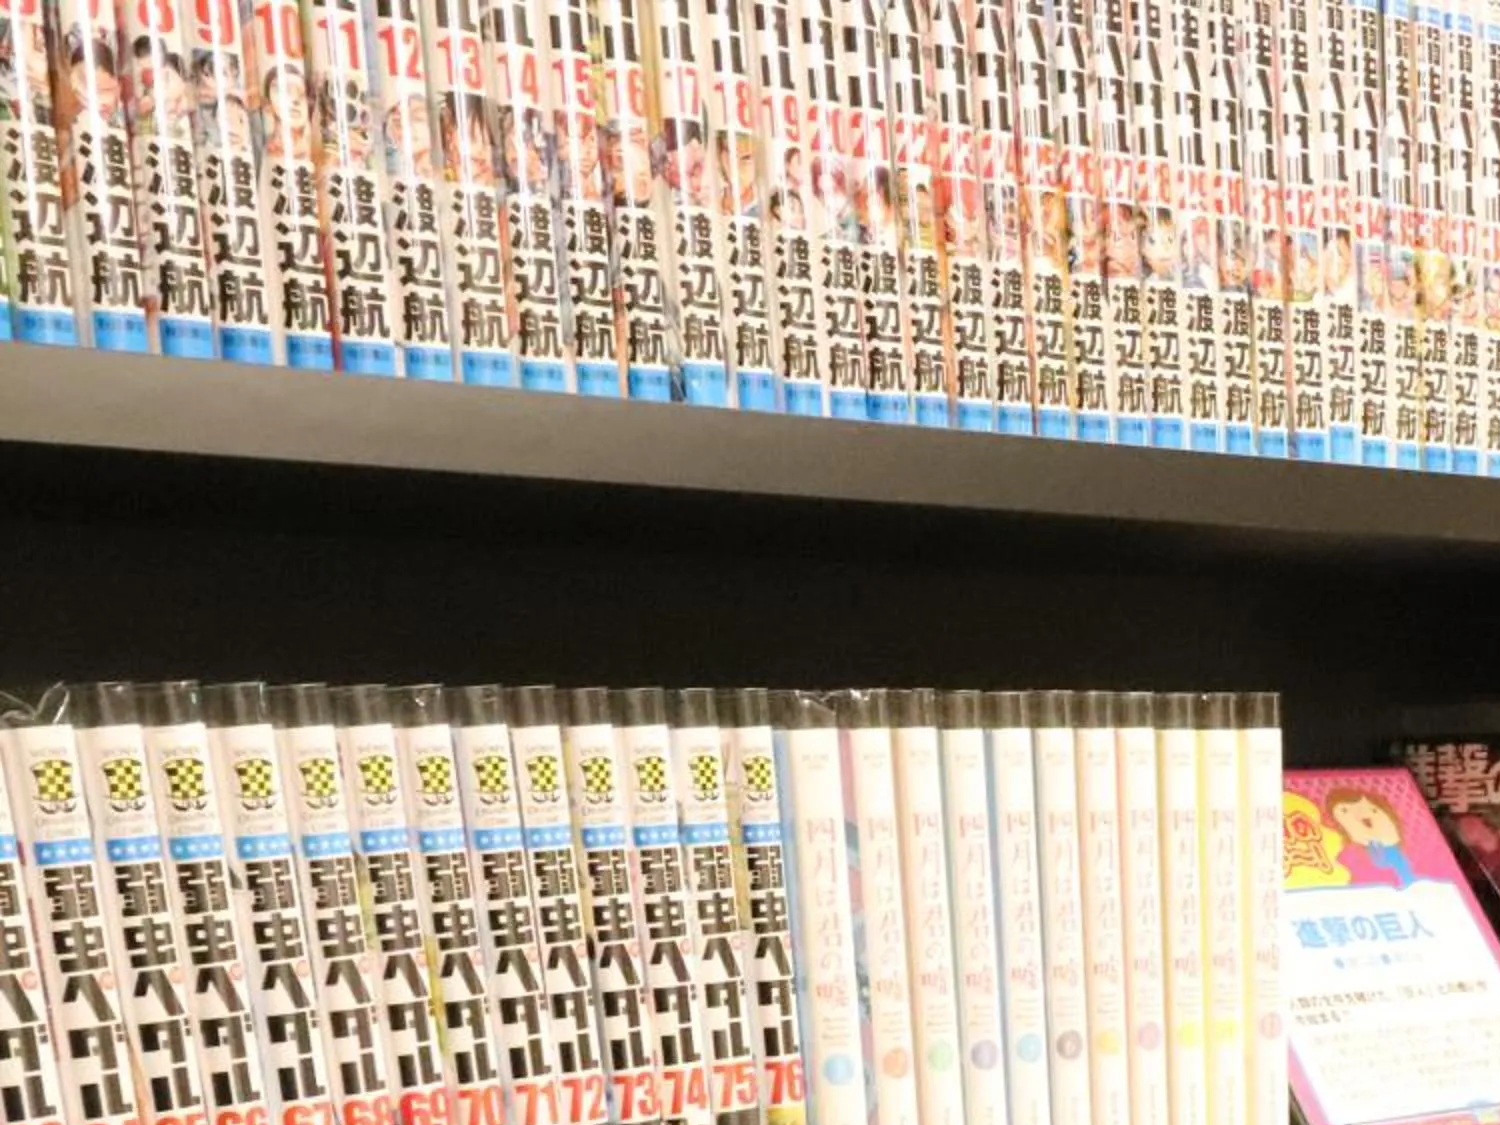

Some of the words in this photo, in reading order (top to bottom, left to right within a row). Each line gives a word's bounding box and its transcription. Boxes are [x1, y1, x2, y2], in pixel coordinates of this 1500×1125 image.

[43, 863, 133, 1119] 弱虫ペダル
[114, 861, 204, 1112] 弱虫ペダル
[176, 859, 261, 1106] 弱虫ペダル
[246, 857, 327, 1100] 弱虫ペダル
[309, 856, 386, 1095] 弱虫ペダル
[368, 852, 441, 1087] 弱虫ペダル
[426, 851, 496, 1083] 弱虫ペダル
[482, 849, 551, 1078] 弱虫ペダル
[534, 848, 600, 1073] 弱虫ペダル
[587, 849, 650, 1070] 弱虫ペダル
[640, 846, 700, 1066] 弱虫ペダル
[693, 845, 749, 1060] 弱虫ペダル
[747, 844, 798, 1057] 弱虫ペダル
[563, 1073, 608, 1124] 72
[614, 1071, 659, 1120] 73
[663, 1064, 709, 1115] 74
[714, 1061, 759, 1109] 75
[765, 1059, 804, 1104] 76
